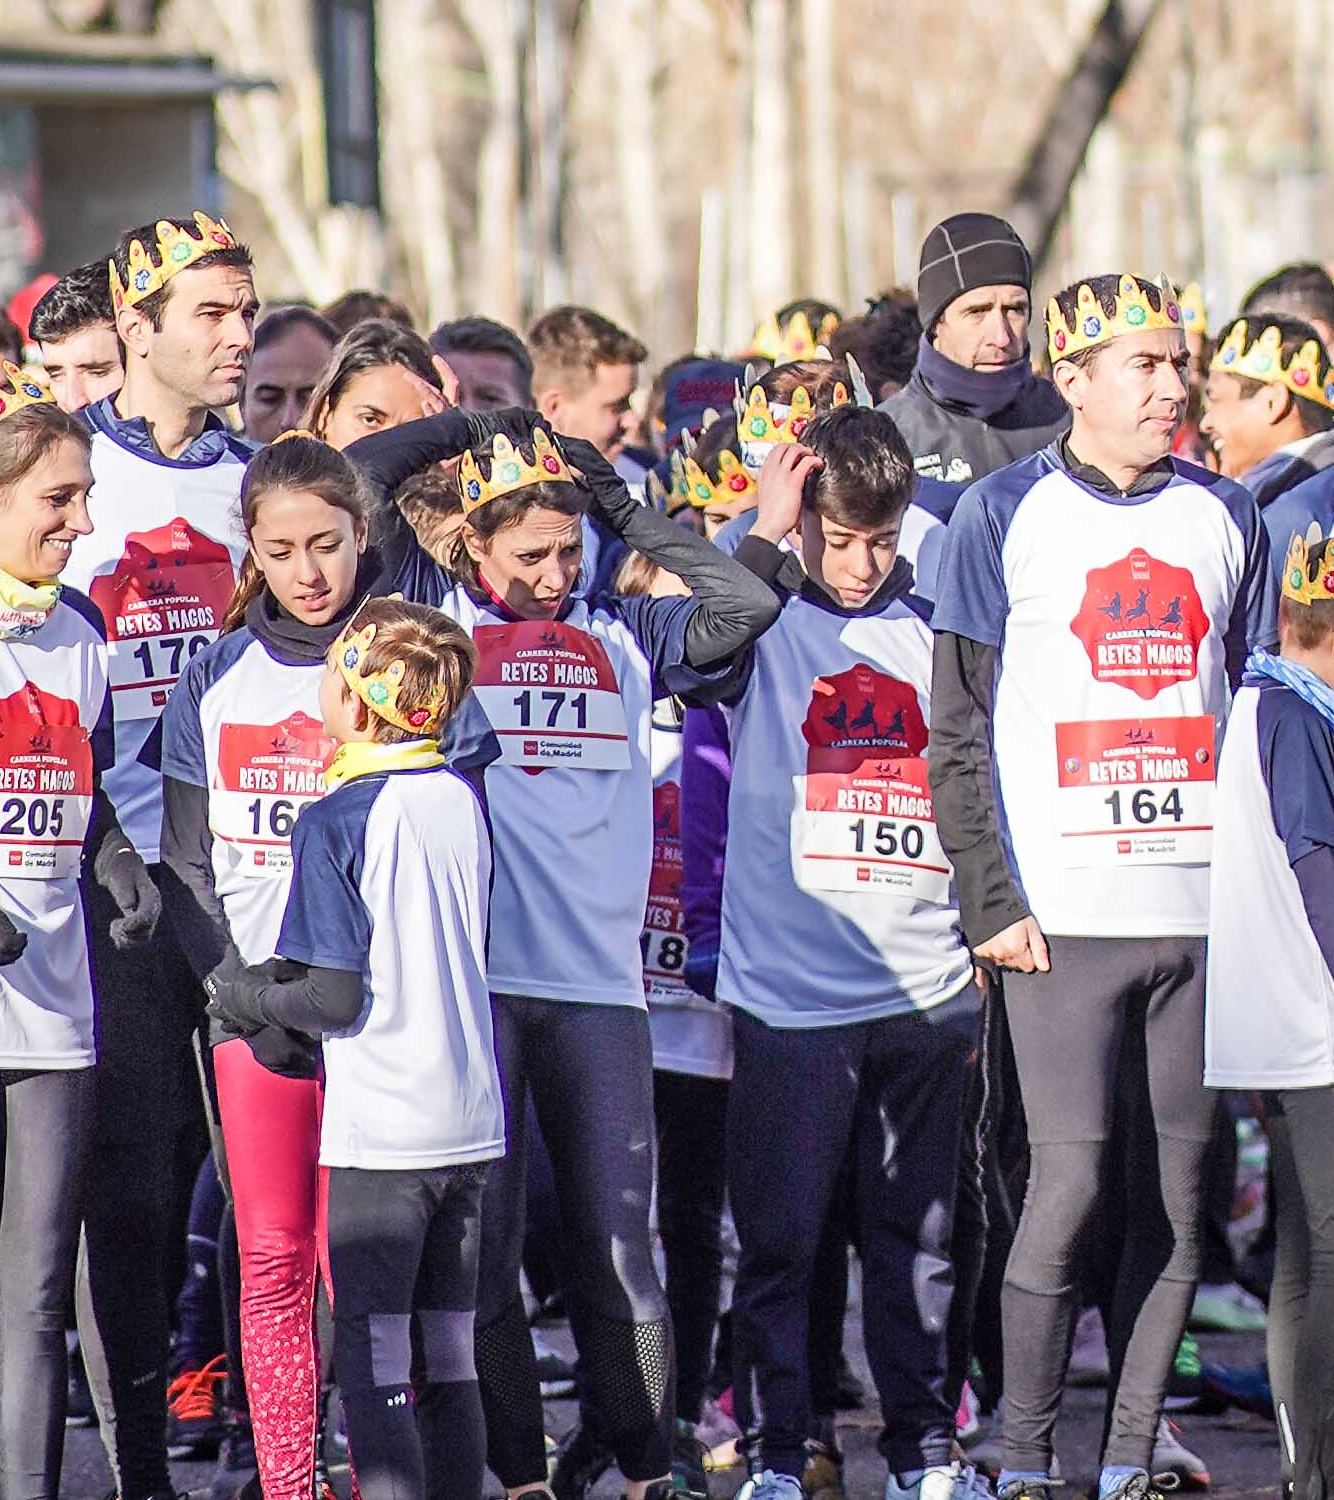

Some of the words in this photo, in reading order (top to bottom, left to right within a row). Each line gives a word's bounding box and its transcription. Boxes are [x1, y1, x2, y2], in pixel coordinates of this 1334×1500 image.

[128, 598, 164, 611] CARRERA
[164, 596, 200, 605] POPULAR
[116, 614, 163, 637] REYES
[168, 606, 215, 631] MAGOS
[516, 650, 554, 658] CARRERA
[555, 650, 586, 661] POPULAR
[1097, 644, 1142, 665] REYES
[1146, 644, 1193, 665] MAGOS
[501, 662, 548, 683] REYES
[554, 663, 598, 685] MAGOS
[514, 690, 586, 729] 171
[831, 738, 870, 748] CARRERA
[872, 738, 908, 748] POPULAR
[40, 769, 75, 791] MAGOS
[239, 767, 278, 791] REYES
[283, 770, 326, 793] MAGO
[1089, 760, 1137, 782] REYES
[1142, 758, 1189, 781] MAGOS
[837, 789, 882, 812] REYES
[887, 793, 932, 819] MAGOS
[1104, 788, 1184, 825] 164
[0, 798, 65, 837] 205
[249, 798, 315, 837] 16
[849, 818, 924, 859] 150
